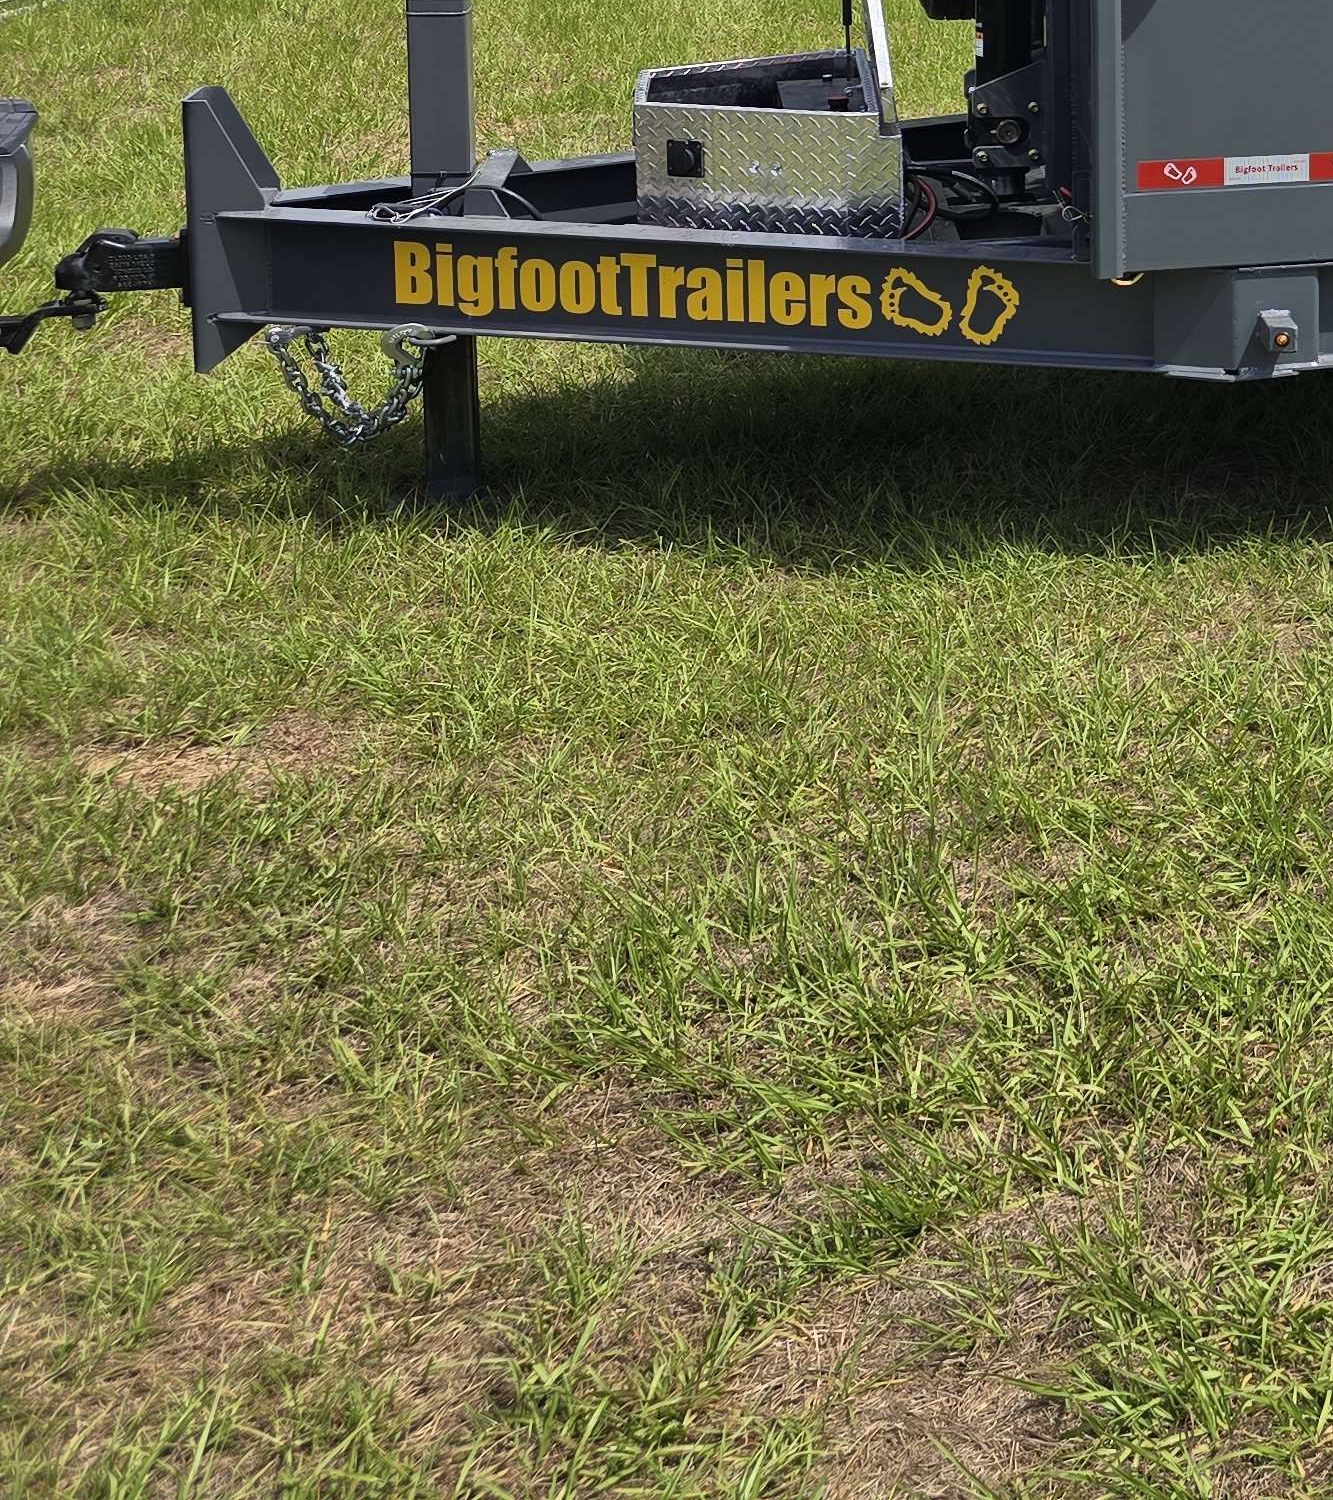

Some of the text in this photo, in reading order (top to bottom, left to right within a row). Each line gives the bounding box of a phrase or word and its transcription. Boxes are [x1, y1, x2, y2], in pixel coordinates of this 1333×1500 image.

[1235, 164, 1299, 175] Bigfoot Trailers
[392, 240, 874, 330] BigfootTrailers
